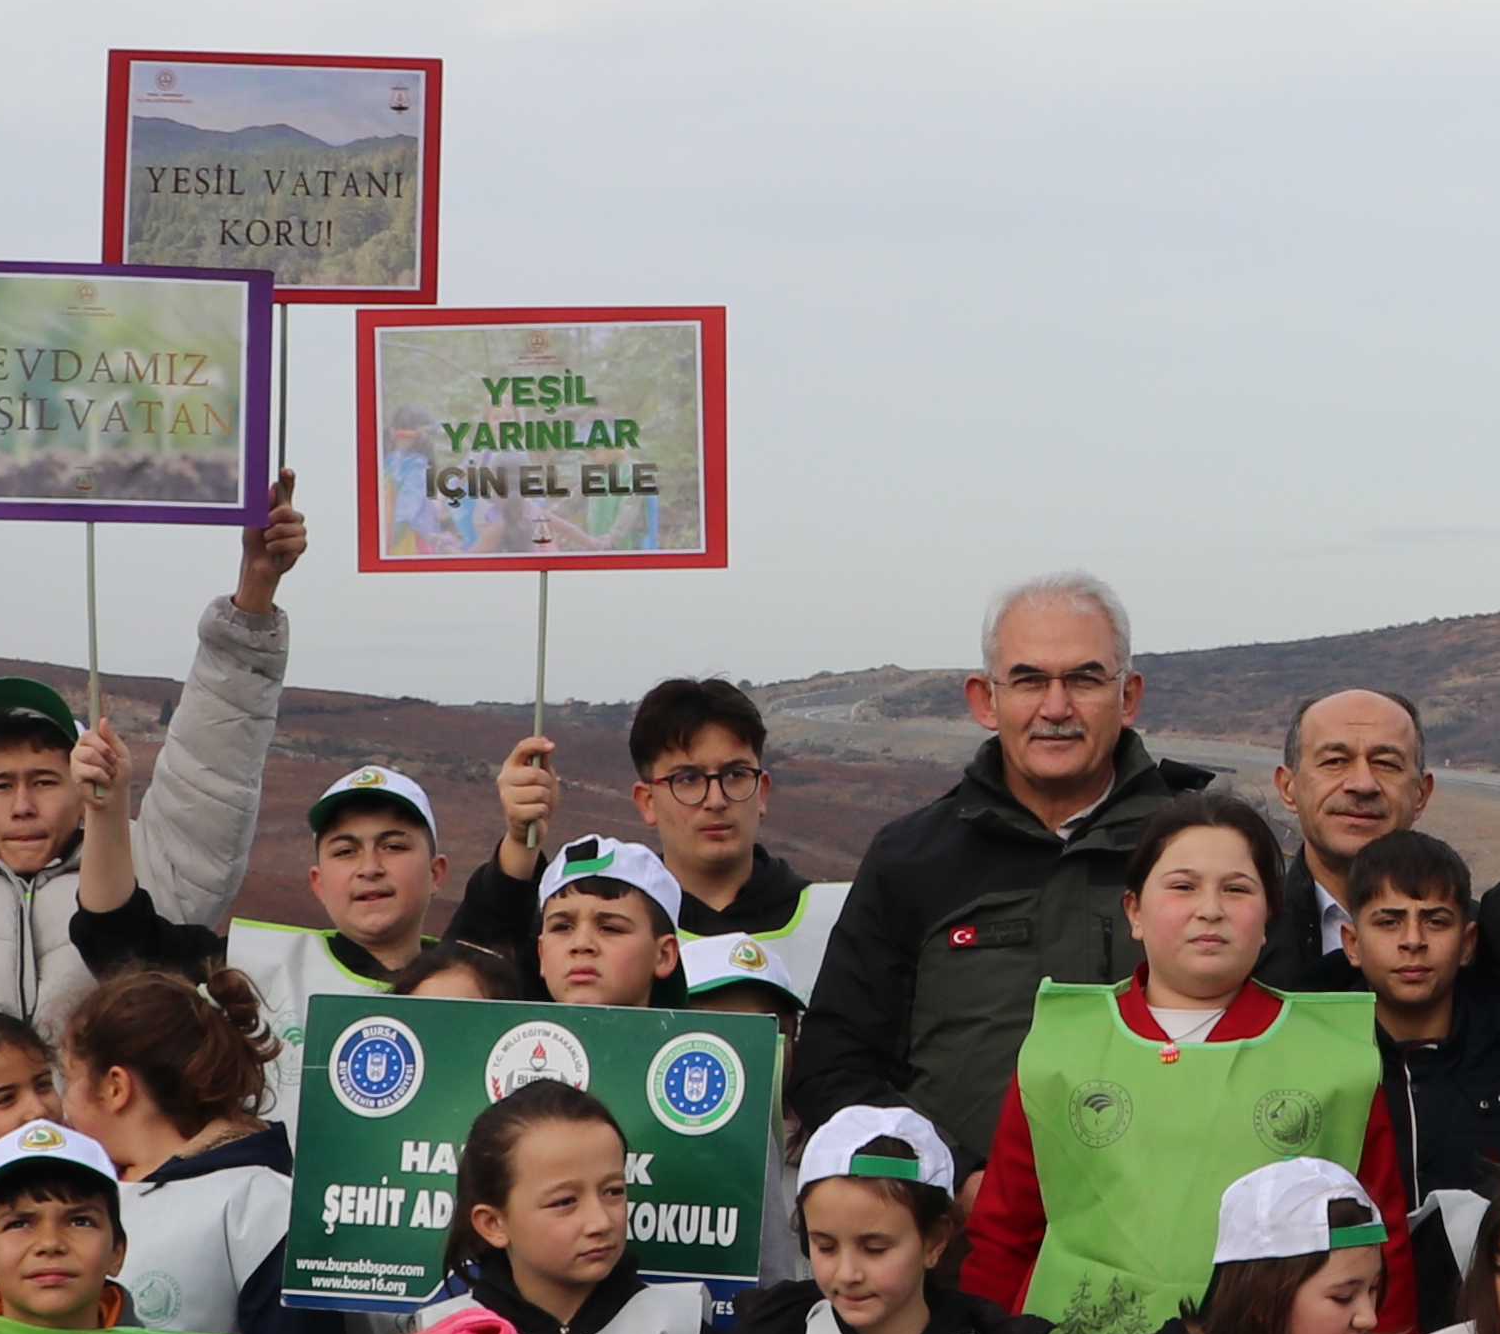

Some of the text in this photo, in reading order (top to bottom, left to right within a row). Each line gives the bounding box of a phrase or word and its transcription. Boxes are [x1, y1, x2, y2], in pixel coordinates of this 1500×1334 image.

[146, 164, 404, 198] YEŞİL VATANI
[219, 219, 333, 247] KORU!
[481, 369, 598, 414] YEŞİL
[442, 418, 640, 452] YARINLAR
[520, 463, 570, 497] EL
[581, 462, 660, 496] ELE
[361, 1026, 399, 1042] BURSA
[321, 1175, 406, 1235] ŞEHİT
[296, 1257, 425, 1278] www.bursabbspor.com
[311, 1275, 407, 1295] www.bose16.org
